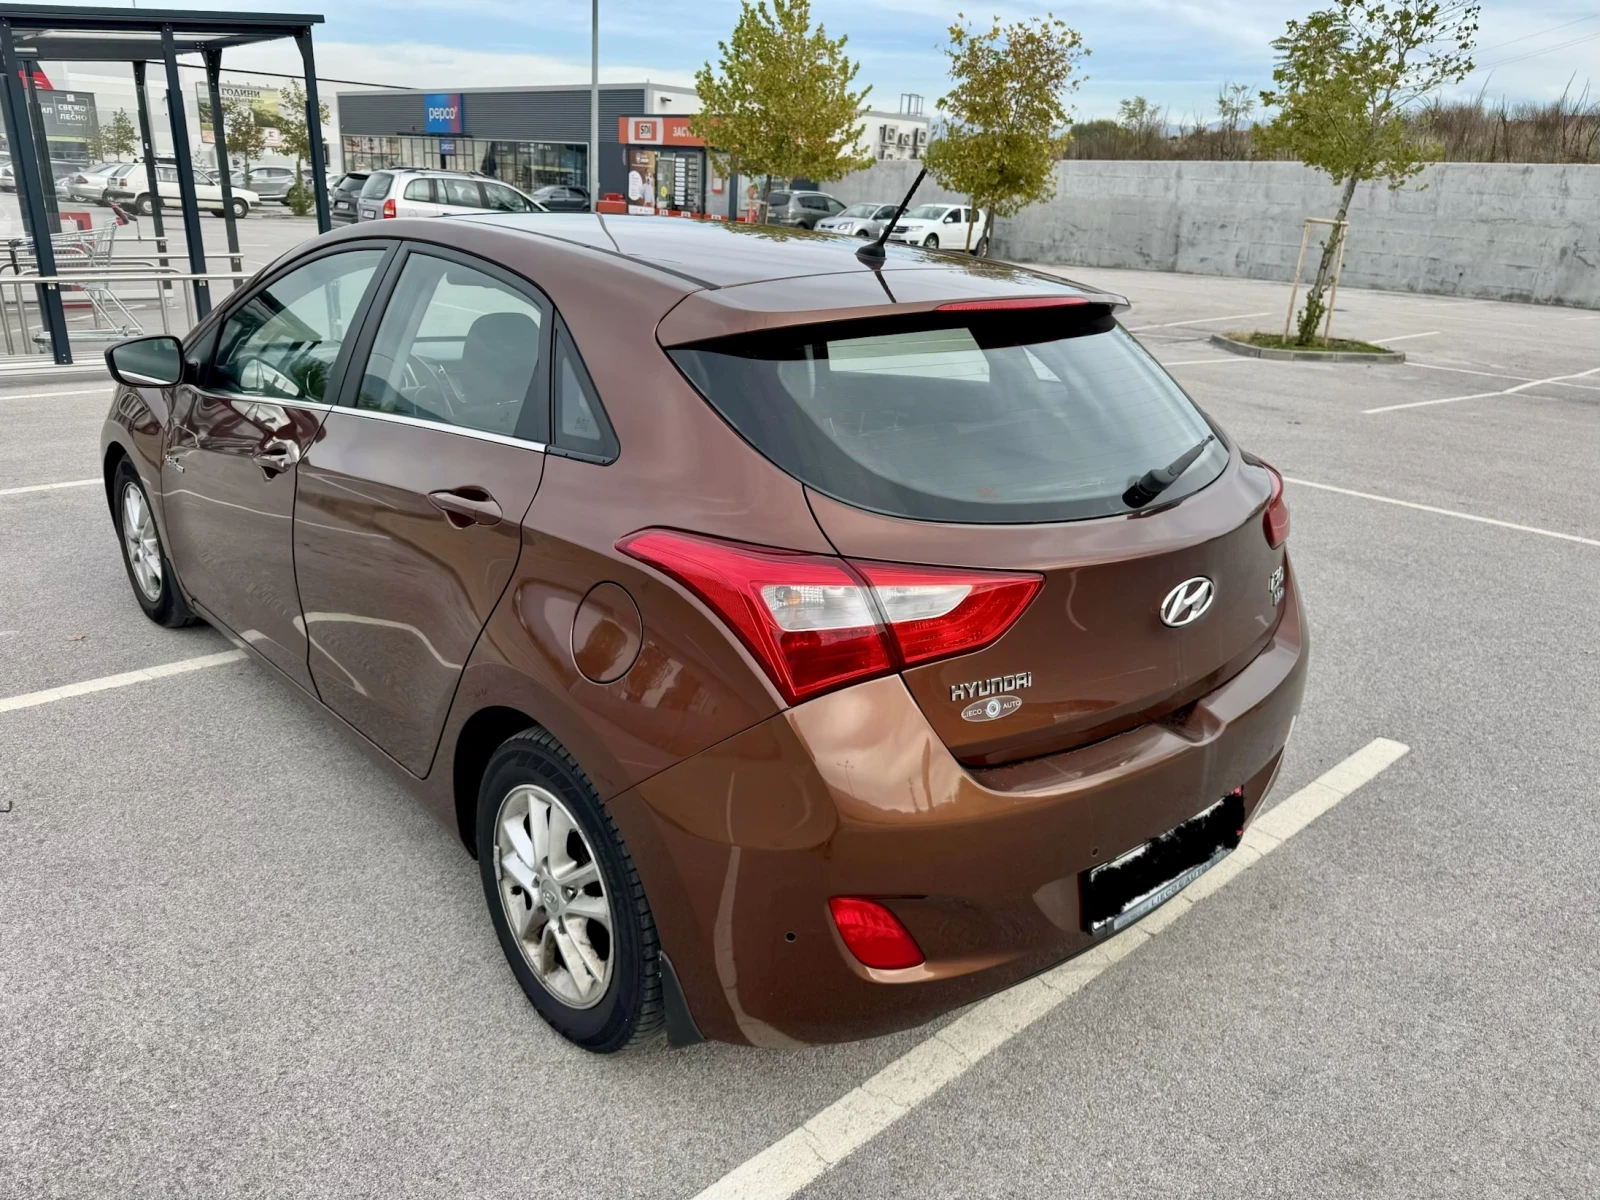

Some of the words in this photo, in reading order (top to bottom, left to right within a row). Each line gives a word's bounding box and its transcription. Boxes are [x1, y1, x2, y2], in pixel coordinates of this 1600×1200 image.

[221, 88, 260, 98] ГОДИНИ
[58, 104, 86, 112] СВЕЖО
[60, 113, 87, 121] ЛЕСНО
[428, 107, 456, 122] pepco
[951, 672, 1032, 701] HYUNDAI
[1002, 700, 1021, 709] AUTO
[1151, 885, 1178, 907] LIECO
[1185, 864, 1208, 883] AUTO
